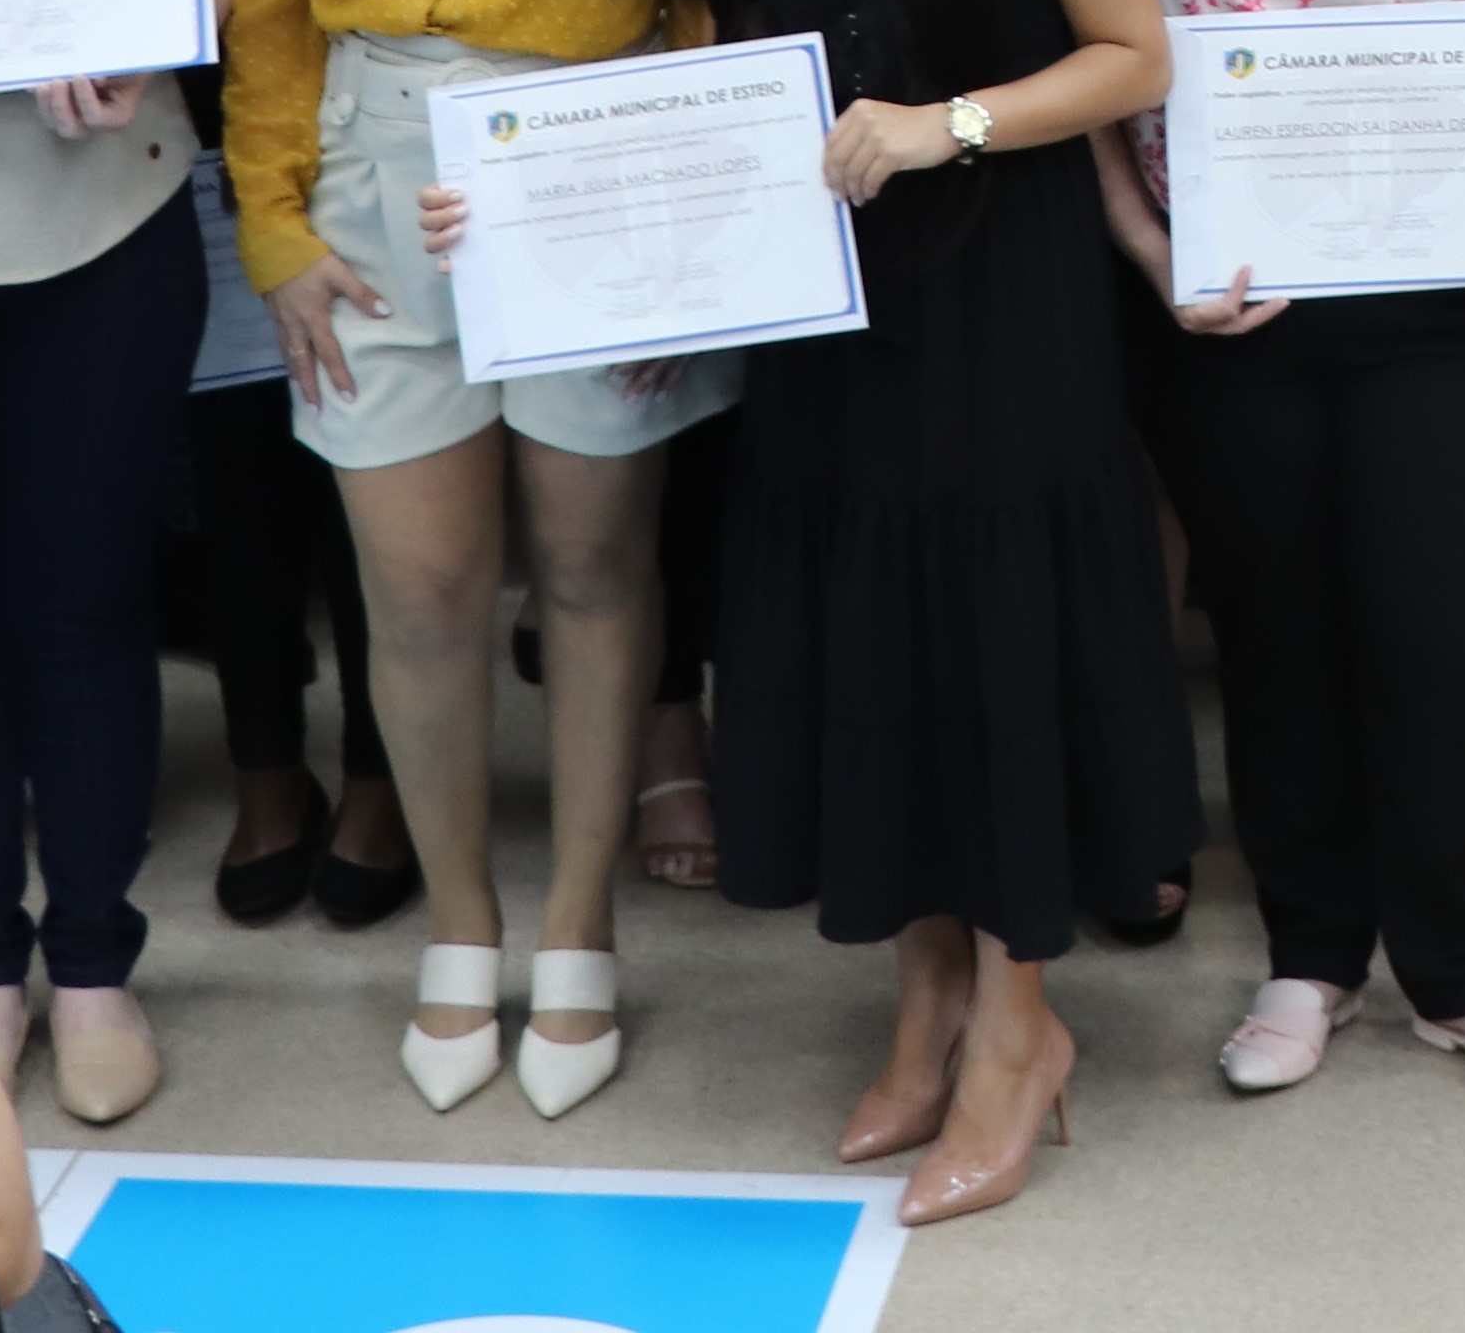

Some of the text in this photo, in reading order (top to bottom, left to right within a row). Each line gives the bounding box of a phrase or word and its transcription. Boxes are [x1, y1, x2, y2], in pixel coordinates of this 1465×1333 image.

[1263, 52, 1340, 70] CÂMARA
[1345, 50, 1438, 68] MUNICIPAL
[1443, 51, 1462, 64] DE
[527, 80, 785, 131] CÂMARA MUNICIPAL DE ESTEIO
[1215, 124, 1271, 139] LAUREN
[1362, 119, 1443, 134] SALDANHA
[527, 182, 577, 202] MARIA
[625, 161, 712, 189] MACHADO
[714, 154, 762, 175] LOPES
